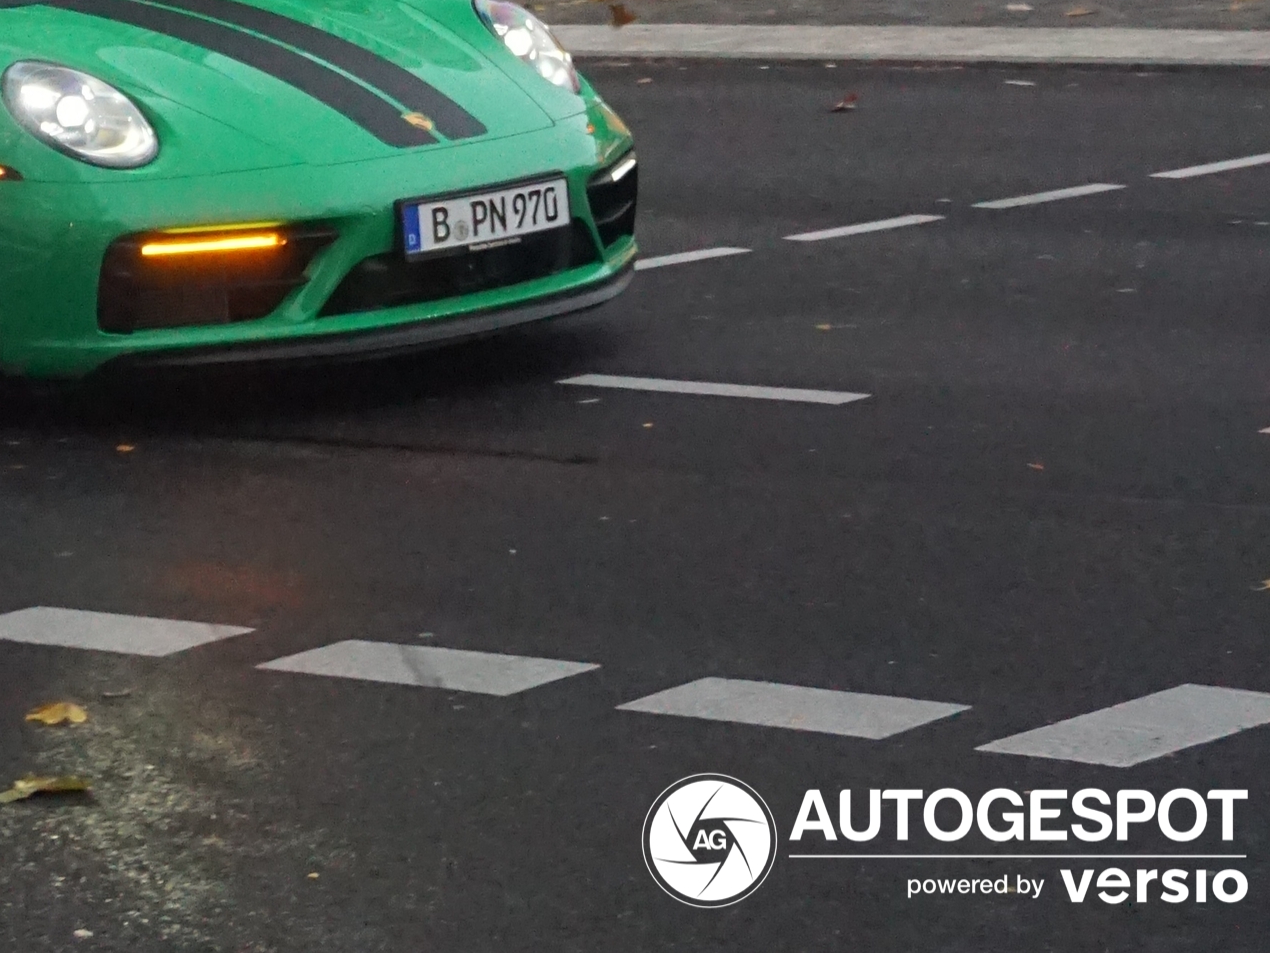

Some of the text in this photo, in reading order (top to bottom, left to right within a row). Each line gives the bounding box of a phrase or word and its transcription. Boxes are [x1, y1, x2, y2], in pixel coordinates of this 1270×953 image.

[431, 186, 559, 244] B PN 970
